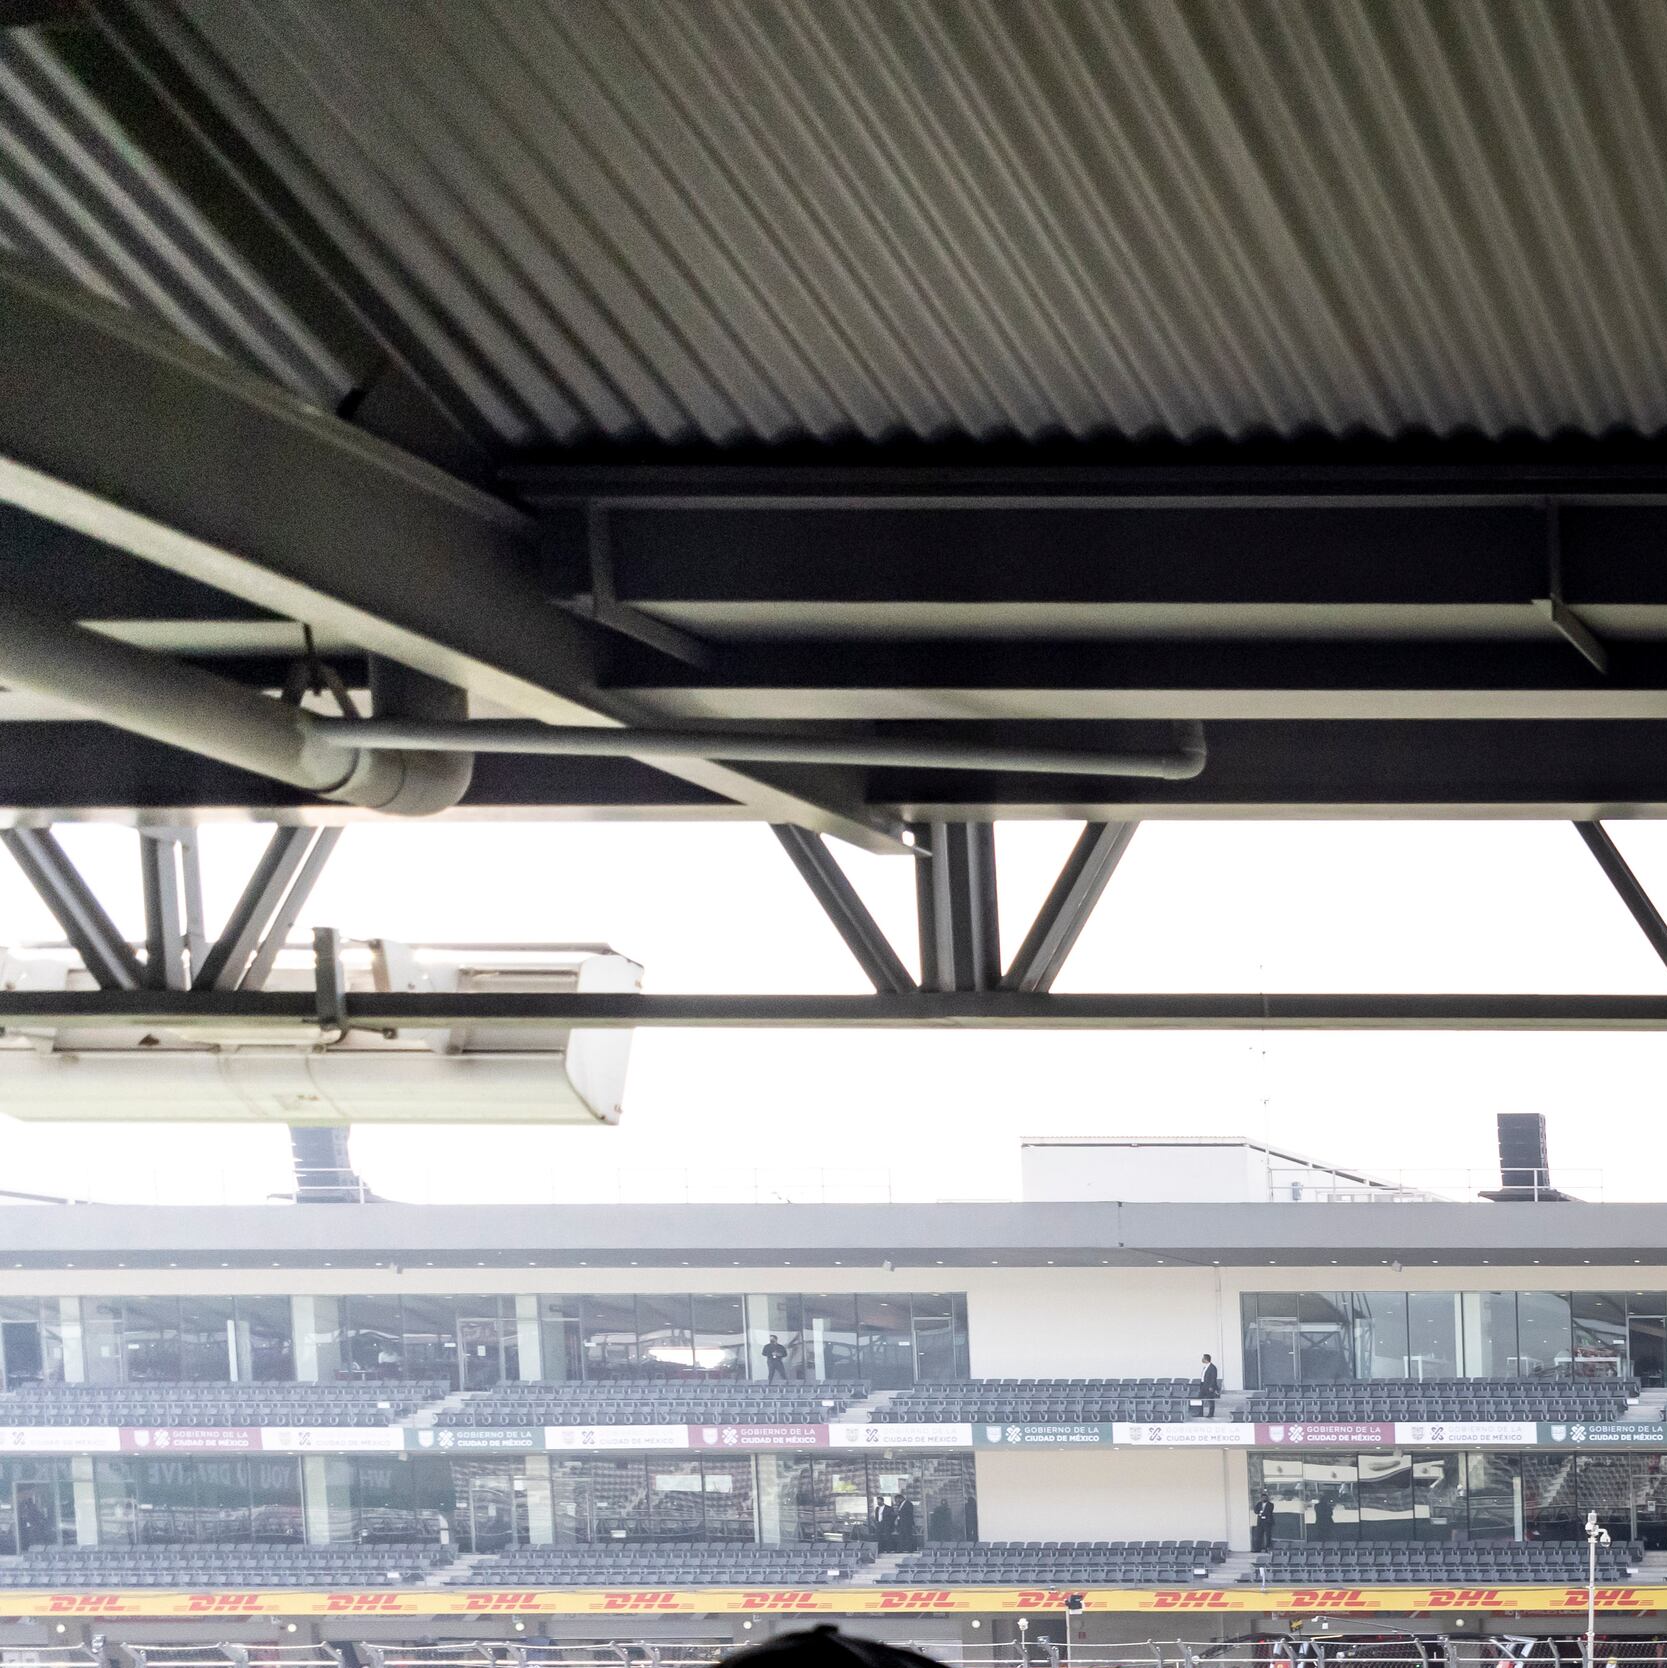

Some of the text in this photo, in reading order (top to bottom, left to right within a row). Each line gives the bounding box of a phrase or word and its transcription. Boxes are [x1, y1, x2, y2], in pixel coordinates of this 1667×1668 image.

[1024, 1426, 1100, 1434] GOBIERNO DE LA
[1589, 1425, 1664, 1433] GOBIERNO DE LA
[1069, 1434, 1100, 1442] MÉXICO
[1307, 1433, 1382, 1442] CIUDAD DE MÉXICO
[1633, 1433, 1664, 1441] MÉXICO
[49, 1595, 124, 1611] DHL
[188, 1595, 263, 1611] DHL
[326, 1594, 402, 1611] DHL
[465, 1594, 541, 1610] DHL
[604, 1594, 679, 1610] DHL
[742, 1593, 817, 1609] DHL
[880, 1592, 954, 1608] DHL
[1155, 1593, 1229, 1608] DHL
[1293, 1592, 1367, 1606] DHL
[1428, 1591, 1502, 1606] DHL
[1565, 1591, 1639, 1606] DHL
